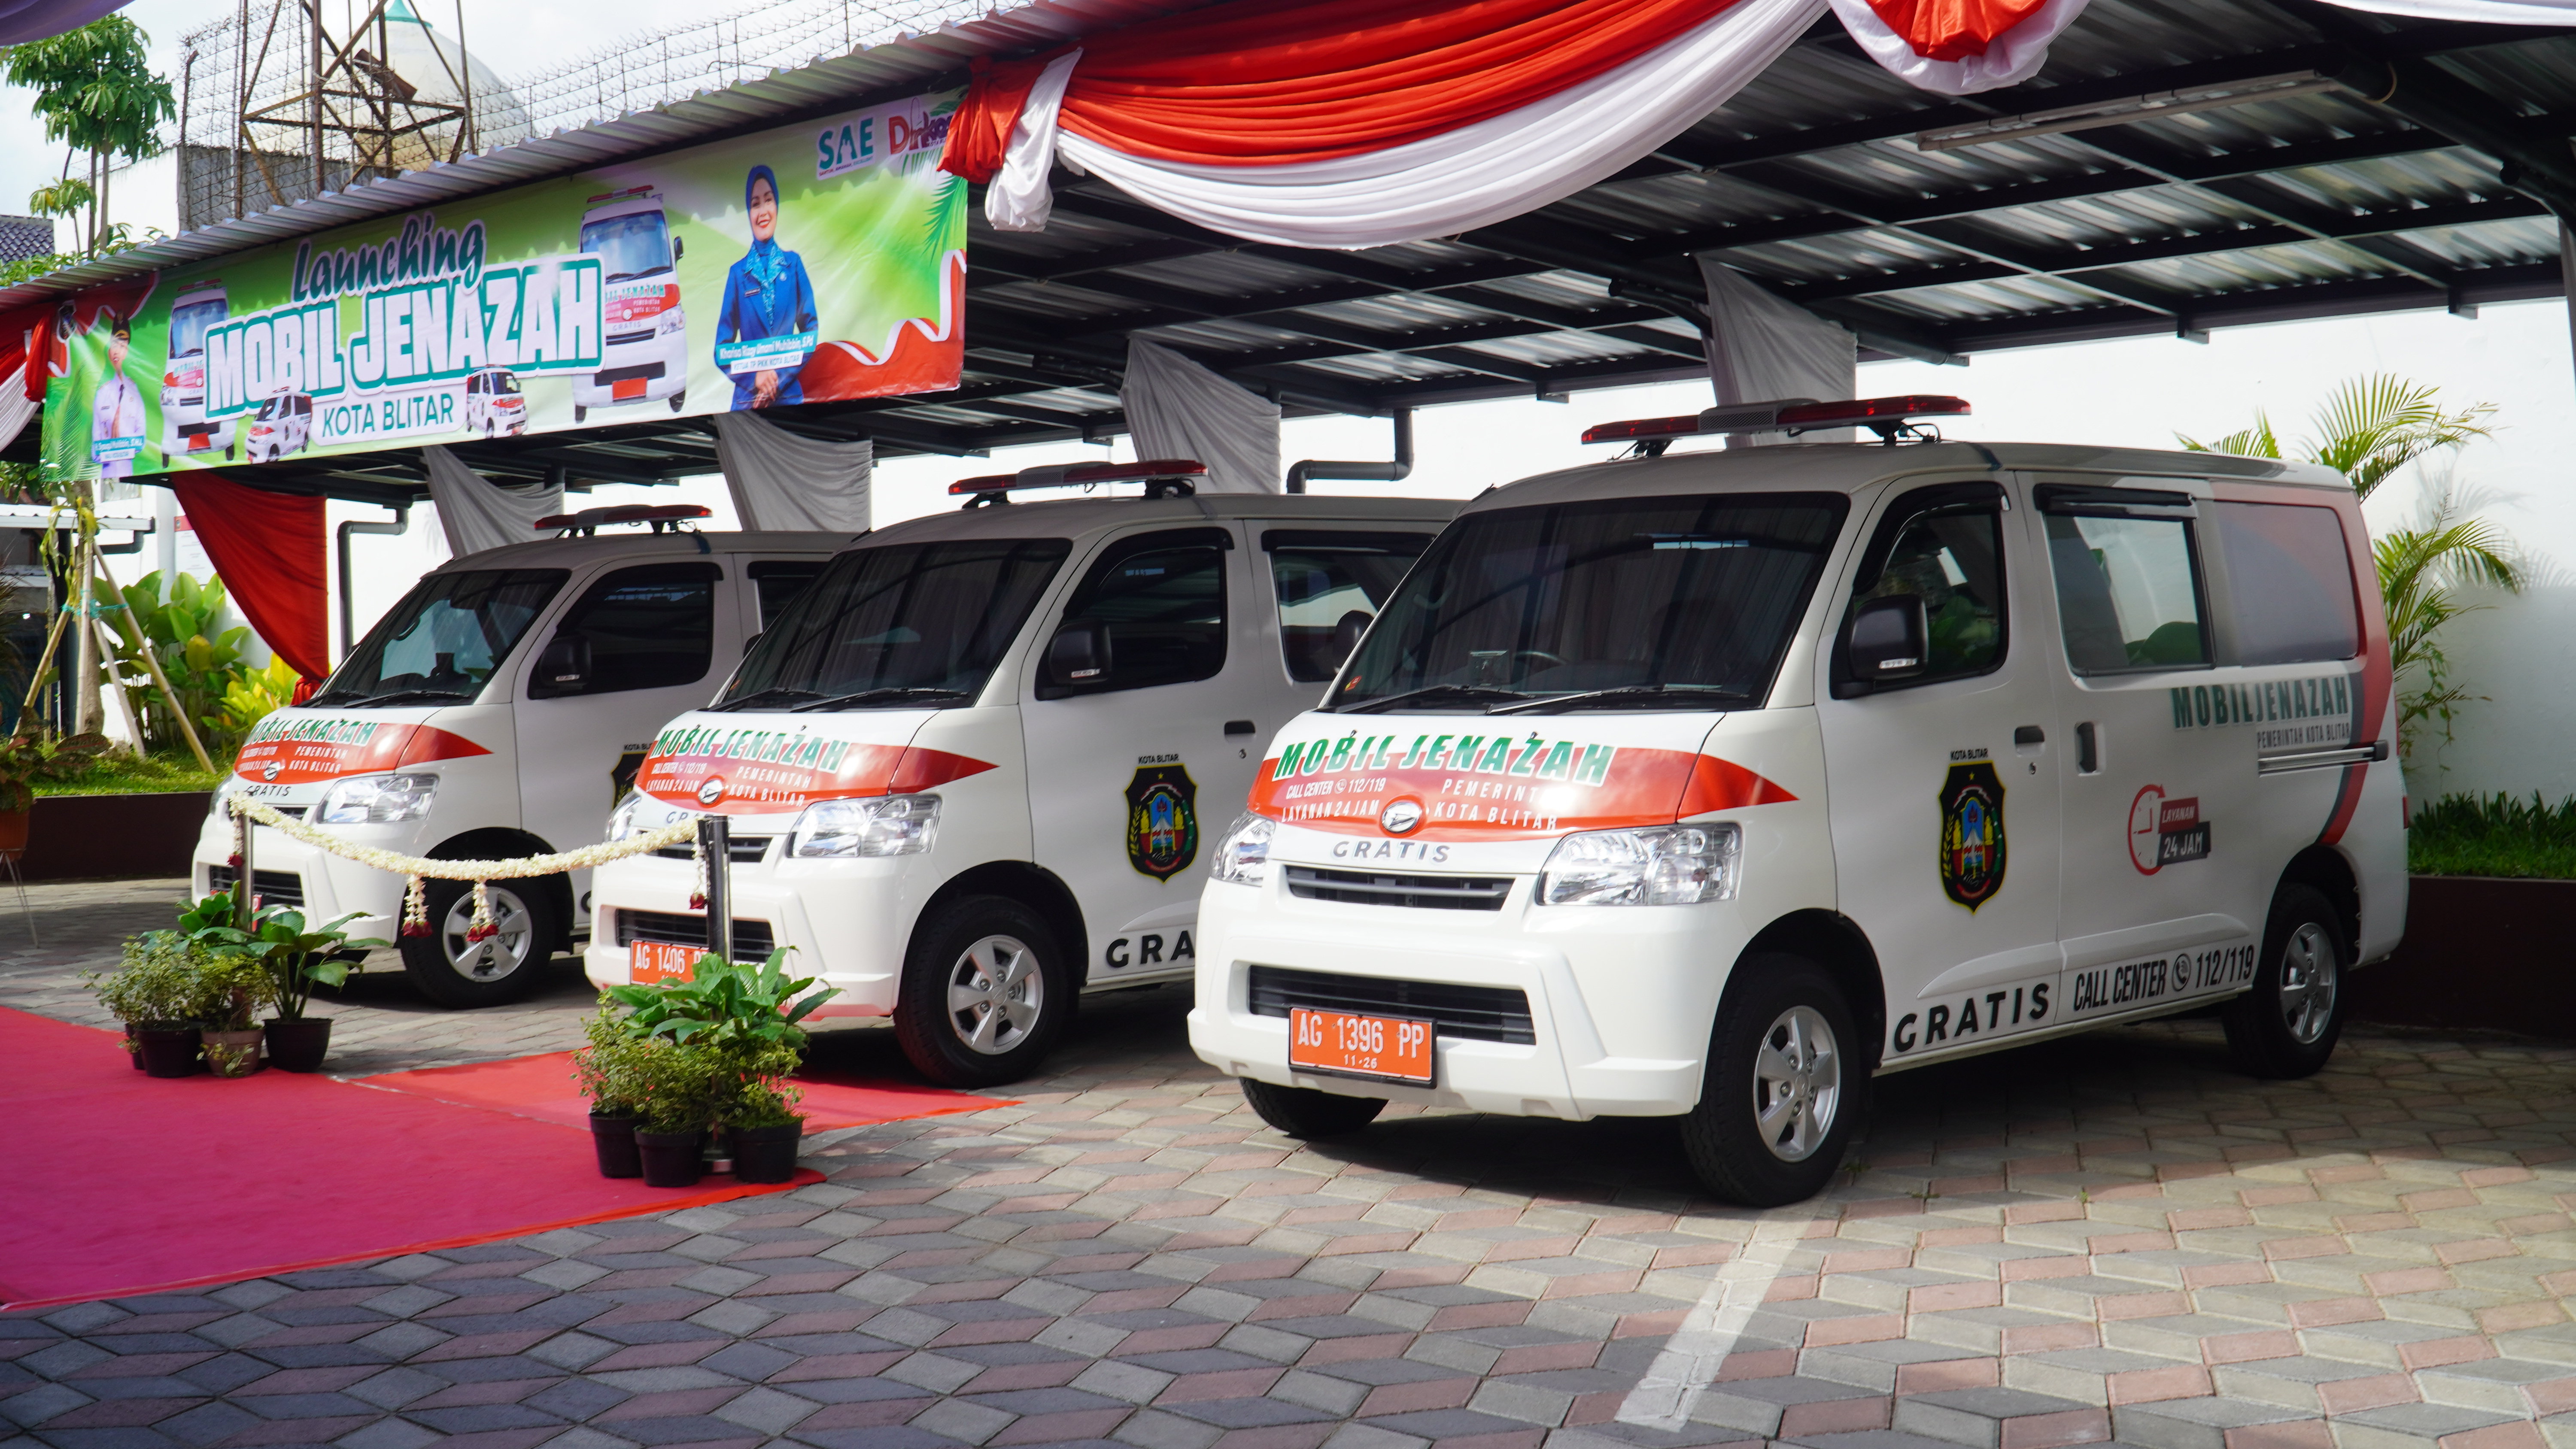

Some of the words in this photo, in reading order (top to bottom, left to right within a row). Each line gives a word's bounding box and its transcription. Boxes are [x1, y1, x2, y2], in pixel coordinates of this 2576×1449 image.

[819, 117, 873, 170] SAE
[294, 213, 484, 302] Launching
[207, 305, 343, 413] MOBIL
[353, 266, 599, 384] JENAZAH
[322, 402, 374, 437] KOTA
[383, 392, 454, 430] BLITAR
[283, 719, 380, 747] JENAZAH
[2257, 728, 2303, 749] PEMERINTAH
[2306, 725, 2324, 743] KOTA
[2326, 722, 2350, 741] BLITAR
[294, 746, 349, 760] PEMERINTAH
[649, 729, 722, 760] MOBIL
[715, 729, 850, 773] JENAZAH
[1138, 755, 1156, 764] KOTA
[1157, 753, 1179, 763] BLITAR
[1273, 735, 1396, 781] MOBIL
[1399, 734, 1617, 786] JENAZAH
[1950, 749, 1967, 761] KOTA
[288, 760, 309, 771] KOTA
[309, 761, 342, 774] BLITAR
[735, 766, 812, 789] PEMERINTAH
[672, 779, 685, 792] 24
[729, 784, 757, 799] KOTA
[760, 788, 805, 807] BLITAR
[1286, 783, 1304, 800] CALL
[1303, 780, 1334, 797] CENTER
[1348, 777, 1387, 793] 112/119
[1441, 778, 1540, 803] PEMERINT
[1281, 801, 1333, 823] LAYANAN
[1334, 800, 1352, 817] 24
[1352, 799, 1380, 816] JAM
[1434, 801, 1479, 821] KOTA
[1487, 806, 1558, 831] BLITAR
[2162, 805, 2195, 824] LAYANAN
[1332, 840, 1451, 863] GRATIS
[2163, 836, 2178, 858] 24
[2180, 831, 2203, 856] JAM
[635, 943, 650, 970] AG
[657, 946, 686, 974] 1406
[1106, 930, 1196, 968] GRA
[1894, 982, 2050, 1052] GRATIS
[2073, 969, 2109, 1012] CALL
[2113, 959, 2168, 1004] CENTER
[2195, 944, 2255, 990] 112/119
[1298, 1012, 1322, 1047] AG
[1337, 1016, 1384, 1054] 1396
[1398, 1023, 1424, 1058] PP
